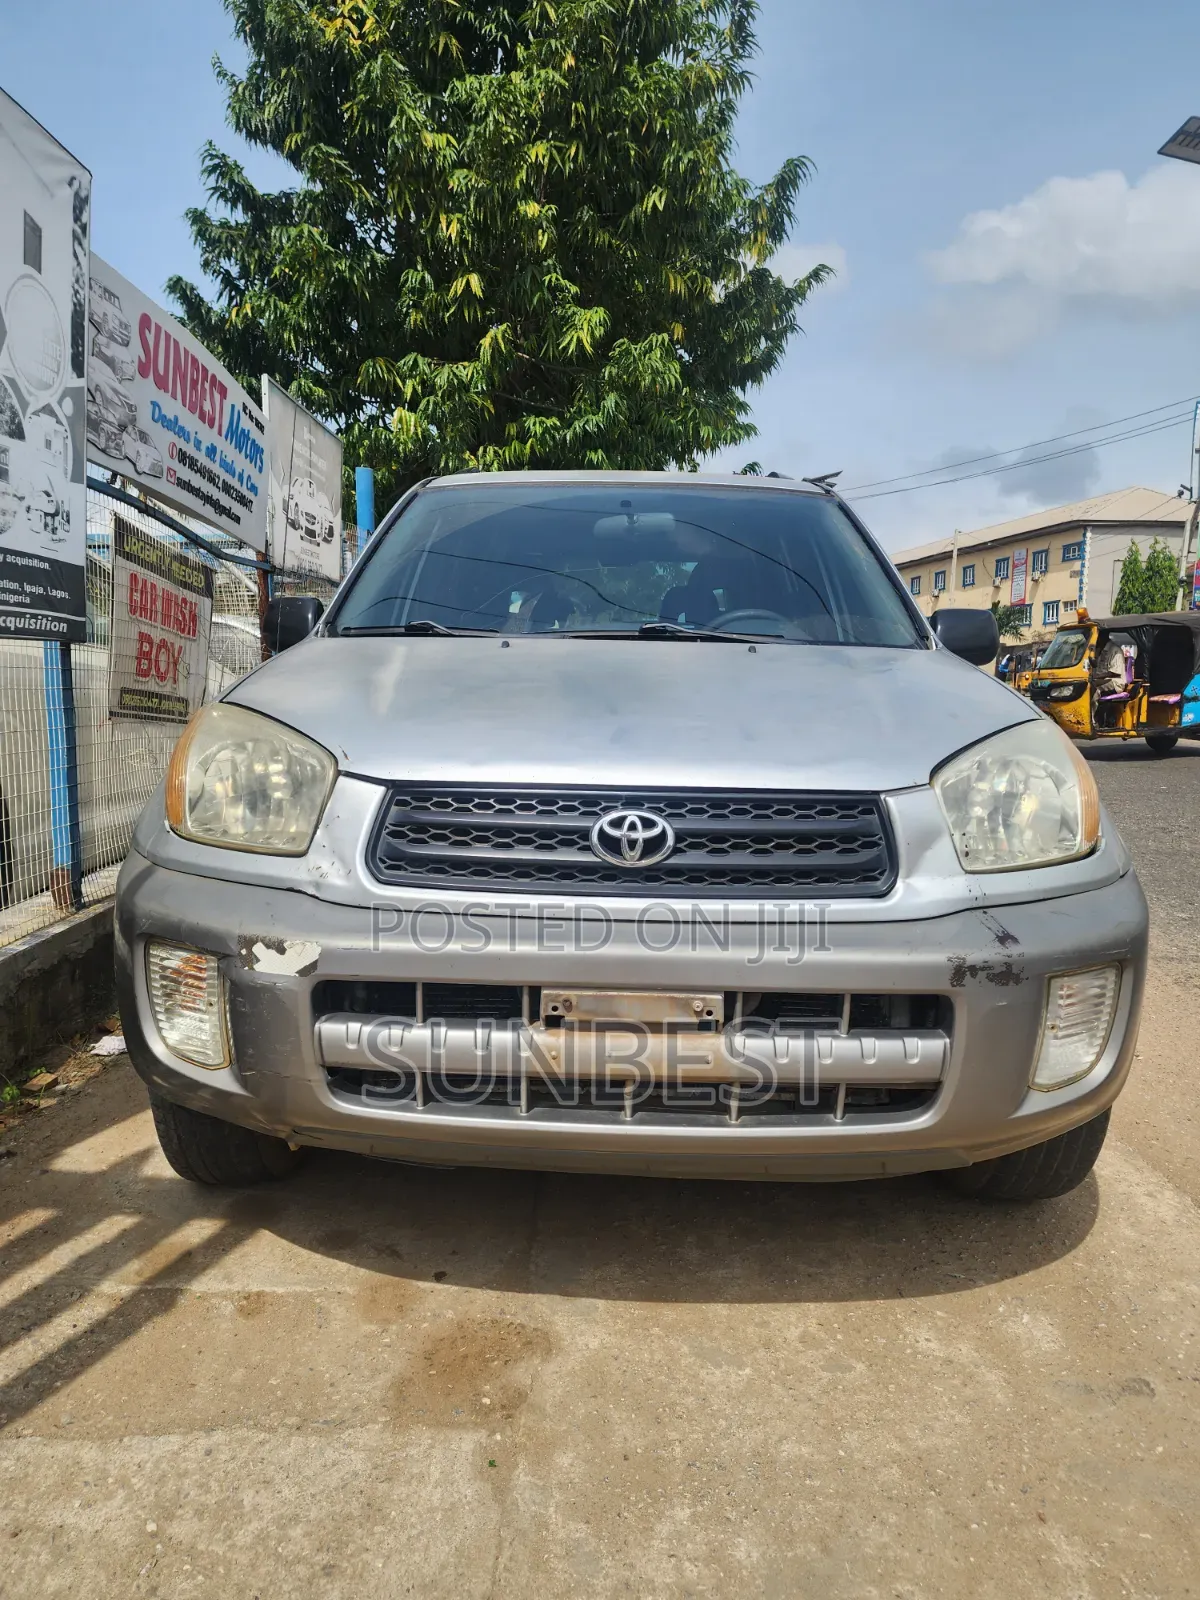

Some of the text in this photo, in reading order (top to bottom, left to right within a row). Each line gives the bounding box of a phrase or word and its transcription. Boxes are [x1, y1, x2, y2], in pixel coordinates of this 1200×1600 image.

[137, 312, 228, 437] SUNBEST
[150, 400, 191, 444] Dealers
[193, 431, 202, 452] in
[205, 442, 217, 464] all
[219, 450, 236, 479] kinds
[246, 474, 258, 497] Cars
[224, 403, 265, 474] Motors
[6, 554, 51, 571] acquisition.
[124, 533, 204, 588] URGENTLY NEEDED
[23, 582, 46, 595] Ipaja,
[47, 586, 71, 600] Lagos.
[128, 572, 198, 637] CAR WASH
[0, 613, 68, 633] cquisition
[135, 631, 183, 685] BOY
